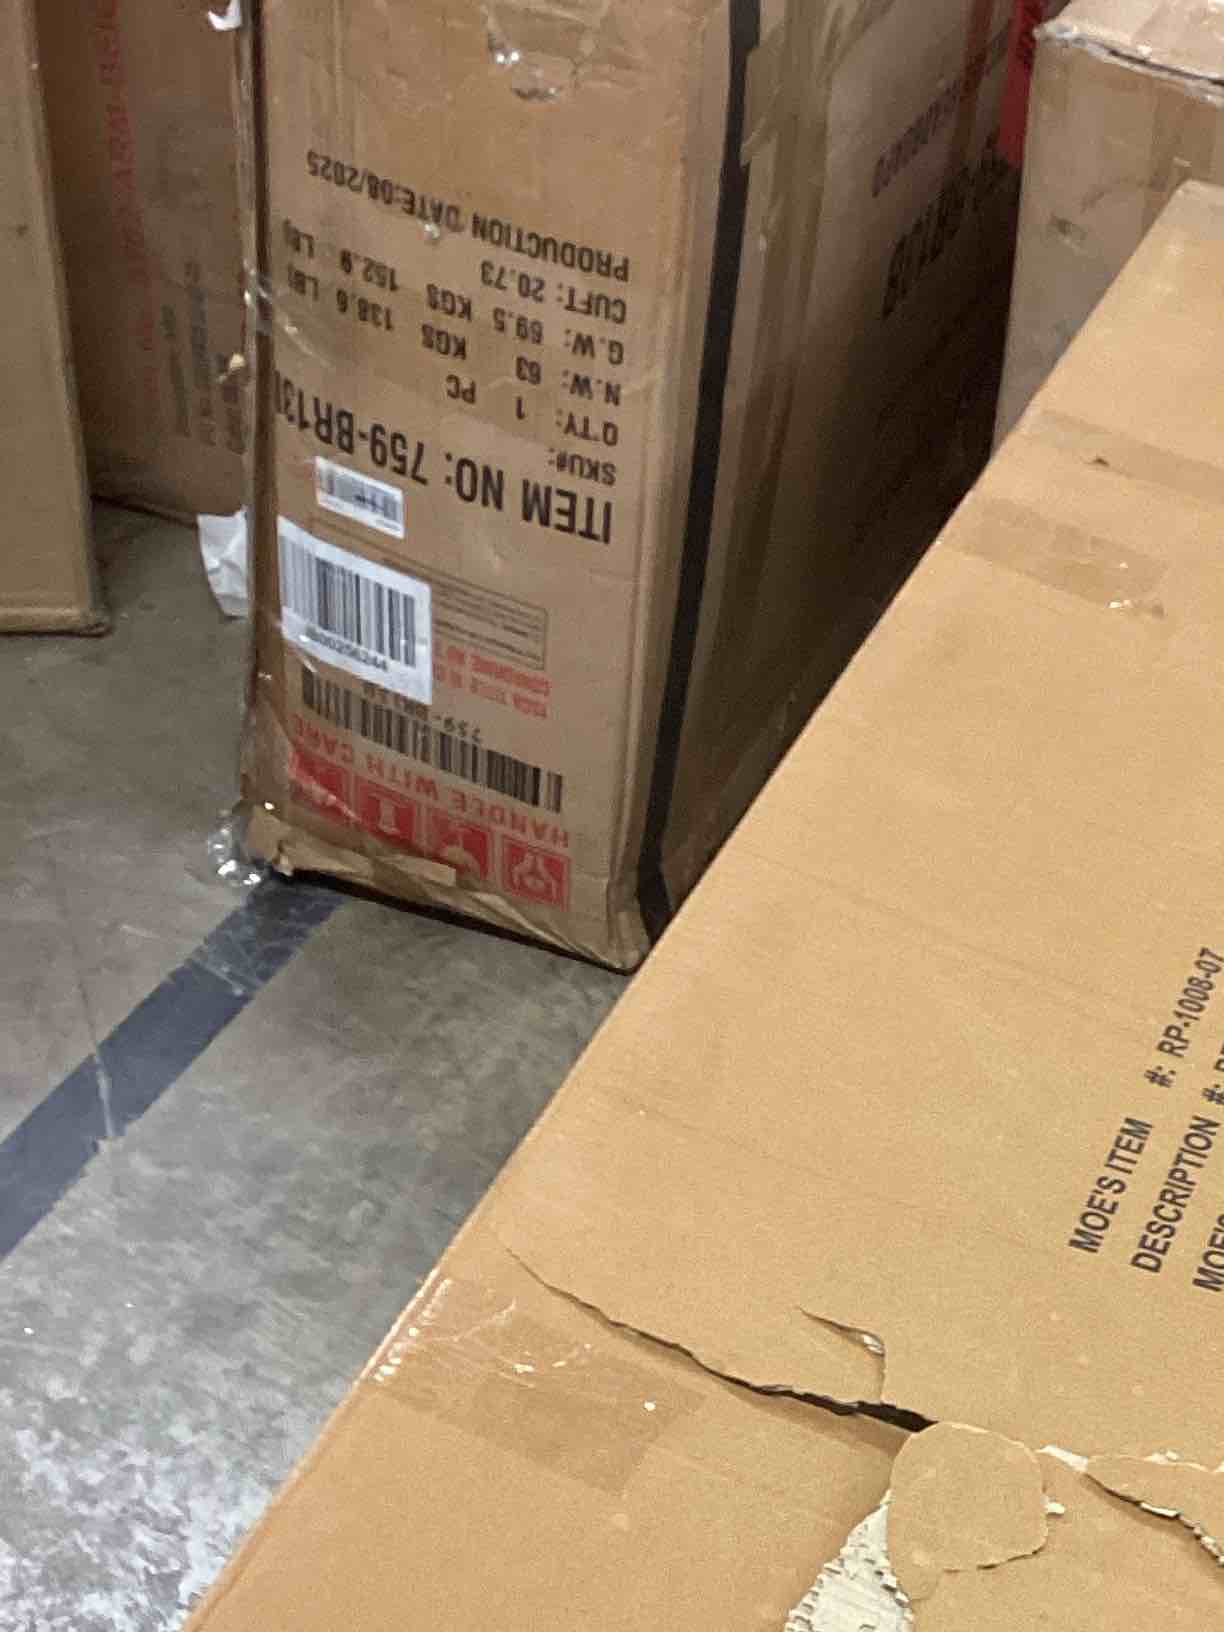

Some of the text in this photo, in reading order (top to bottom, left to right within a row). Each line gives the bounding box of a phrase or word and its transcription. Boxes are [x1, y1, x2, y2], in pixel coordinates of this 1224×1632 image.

[472, 212, 629, 282] PRODUCTION
[339, 249, 399, 291] 152.9
[336, 288, 394, 331] 138.6
[427, 283, 471, 320] KGS
[480, 259, 627, 324] CUFT: 20.73
[422, 323, 468, 360] KGS
[492, 307, 543, 345] 69.5
[564, 330, 624, 366] G.W:
[445, 374, 476, 404] PC
[515, 355, 542, 385] 63
[562, 370, 621, 407] N.W:
[514, 396, 526, 420] 1
[445, 452, 504, 511] NO:
[547, 447, 617, 486] SKU#:
[521, 478, 612, 544] ITEM
[289, 712, 569, 848] HANDLE WITH CARE
[1069, 1174, 1126, 1255] MOE'S
[1105, 1117, 1154, 1175] ITEM
[1131, 1116, 1221, 1274] DESCRIPTION
